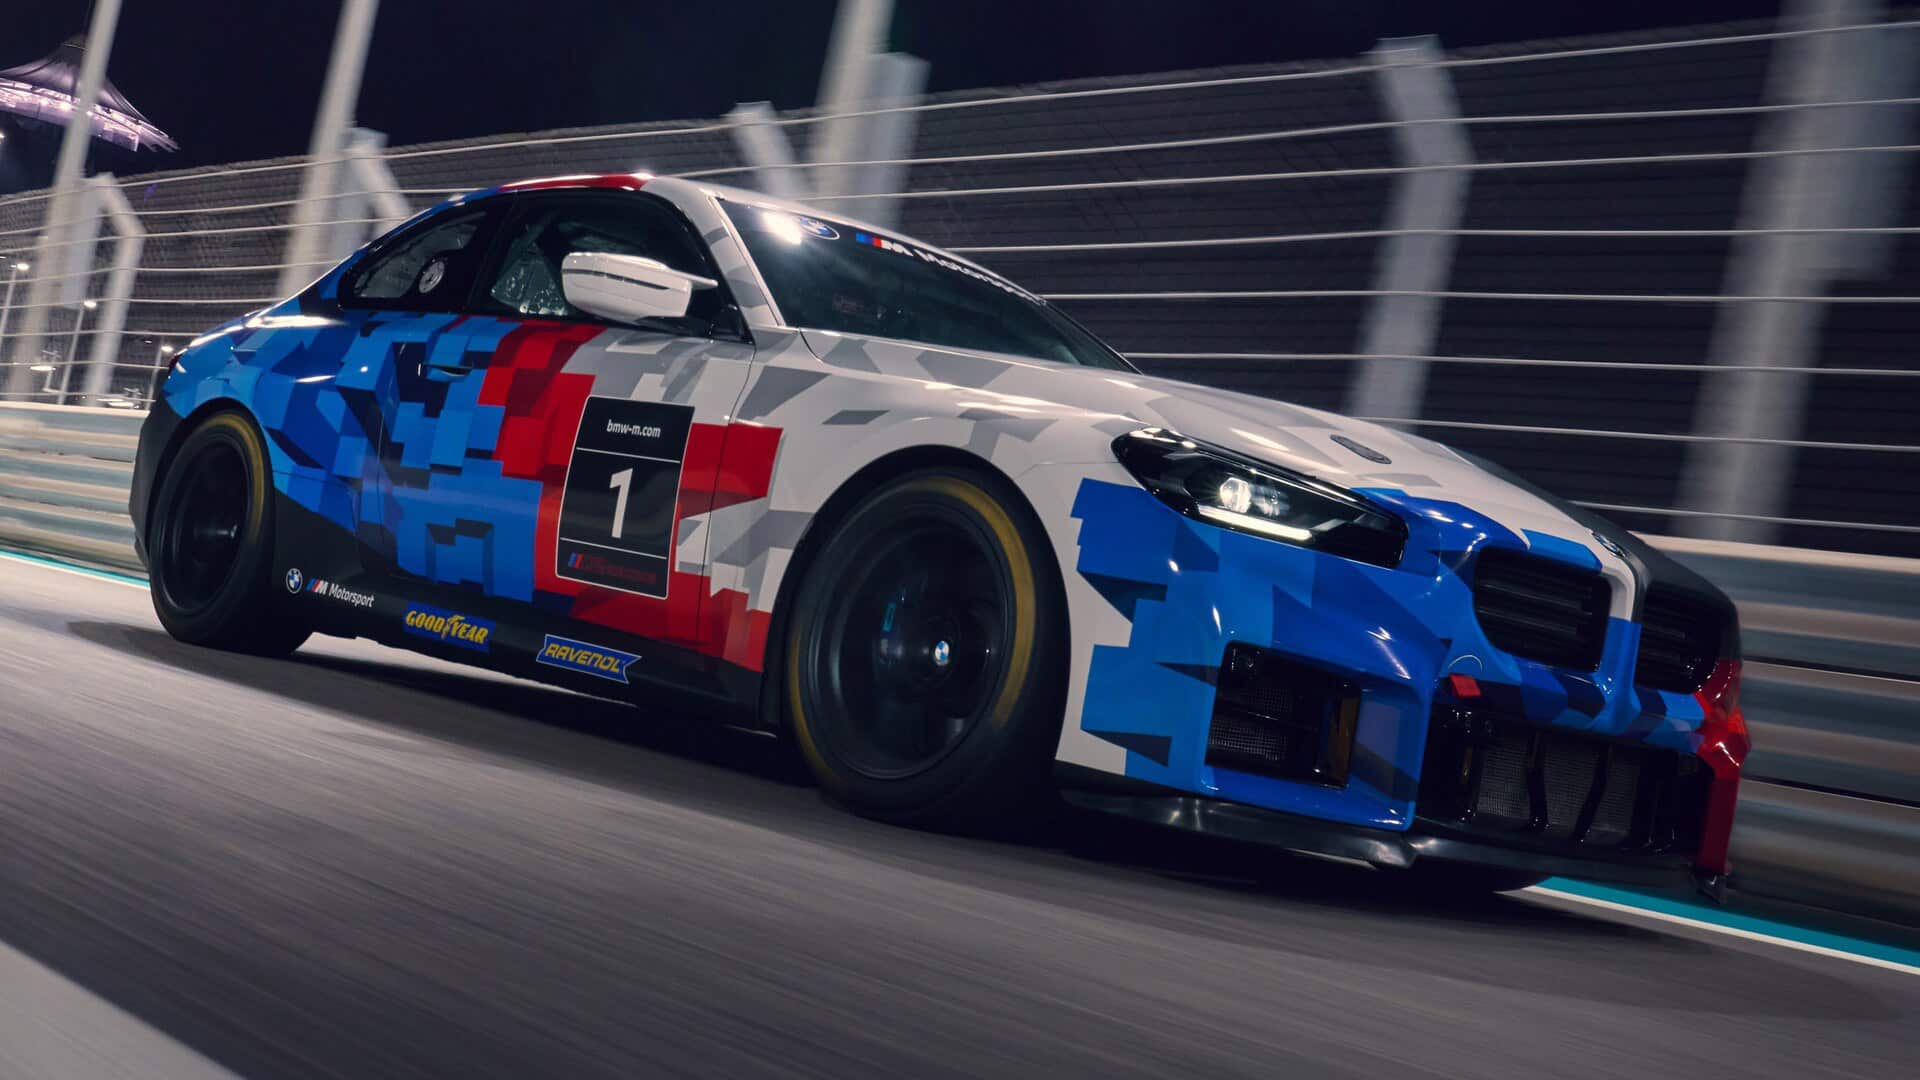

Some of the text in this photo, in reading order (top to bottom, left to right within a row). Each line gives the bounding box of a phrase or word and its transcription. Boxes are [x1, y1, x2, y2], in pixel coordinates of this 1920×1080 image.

[606, 419, 661, 438] bmw-m.com
[609, 468, 633, 539] 1
[329, 583, 375, 608] Motorsport
[405, 610, 489, 645] GOODYEAR
[544, 642, 621, 673] RAVENOL
